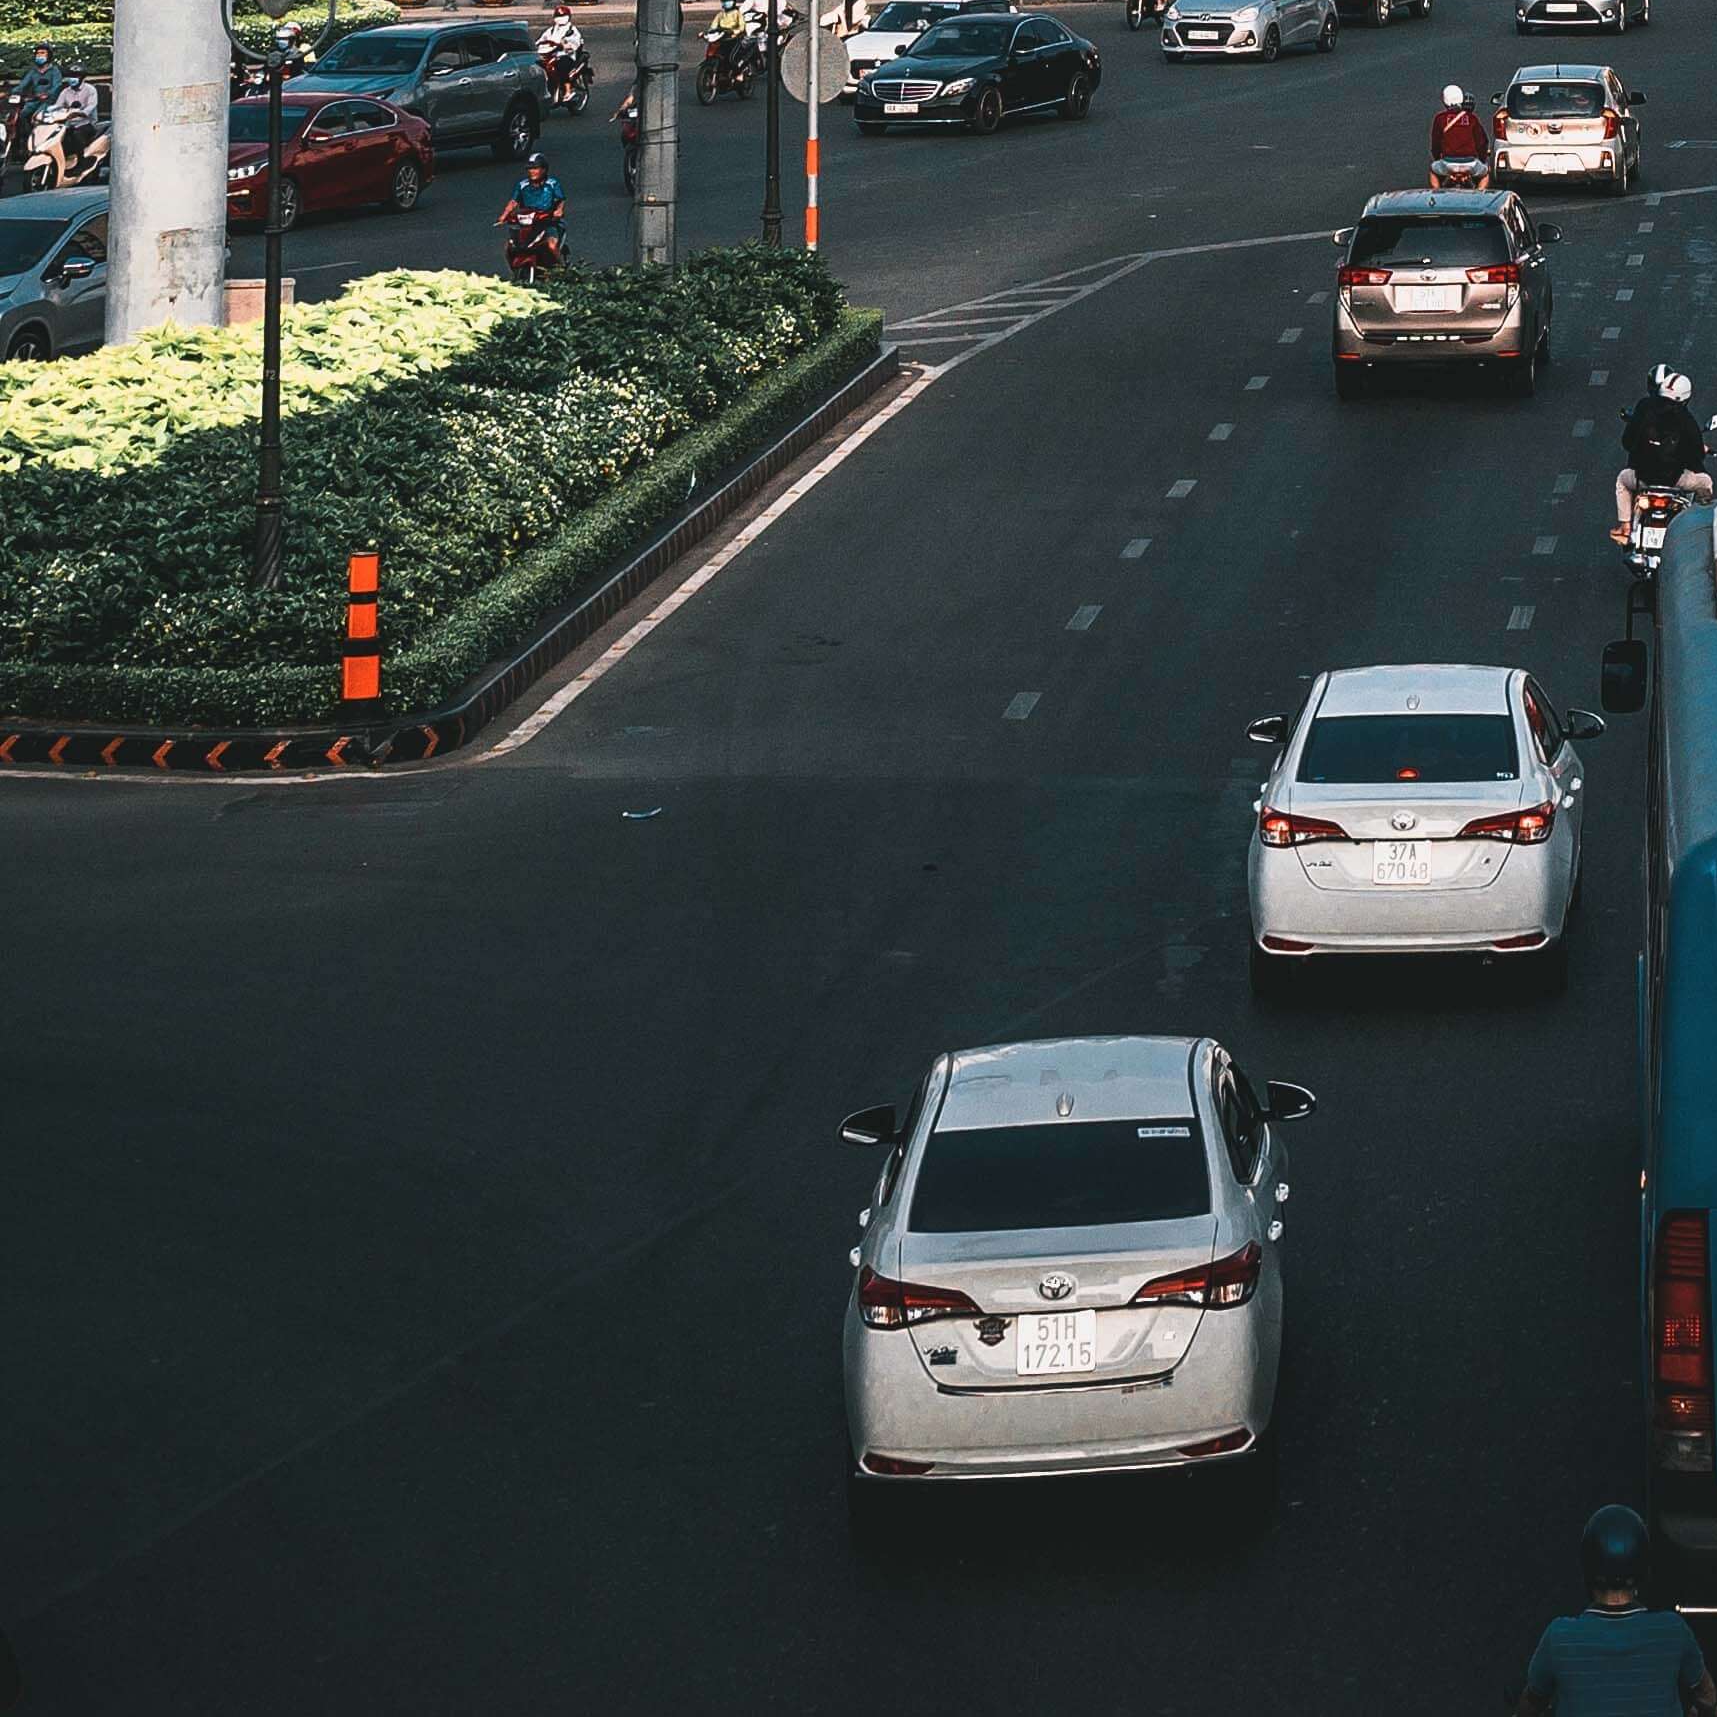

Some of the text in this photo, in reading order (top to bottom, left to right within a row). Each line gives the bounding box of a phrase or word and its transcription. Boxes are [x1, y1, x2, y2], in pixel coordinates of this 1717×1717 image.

[1389, 843, 1417, 861] 37A
[1037, 1316, 1077, 1341] 51H
[1023, 1341, 1092, 1370] 172.15
